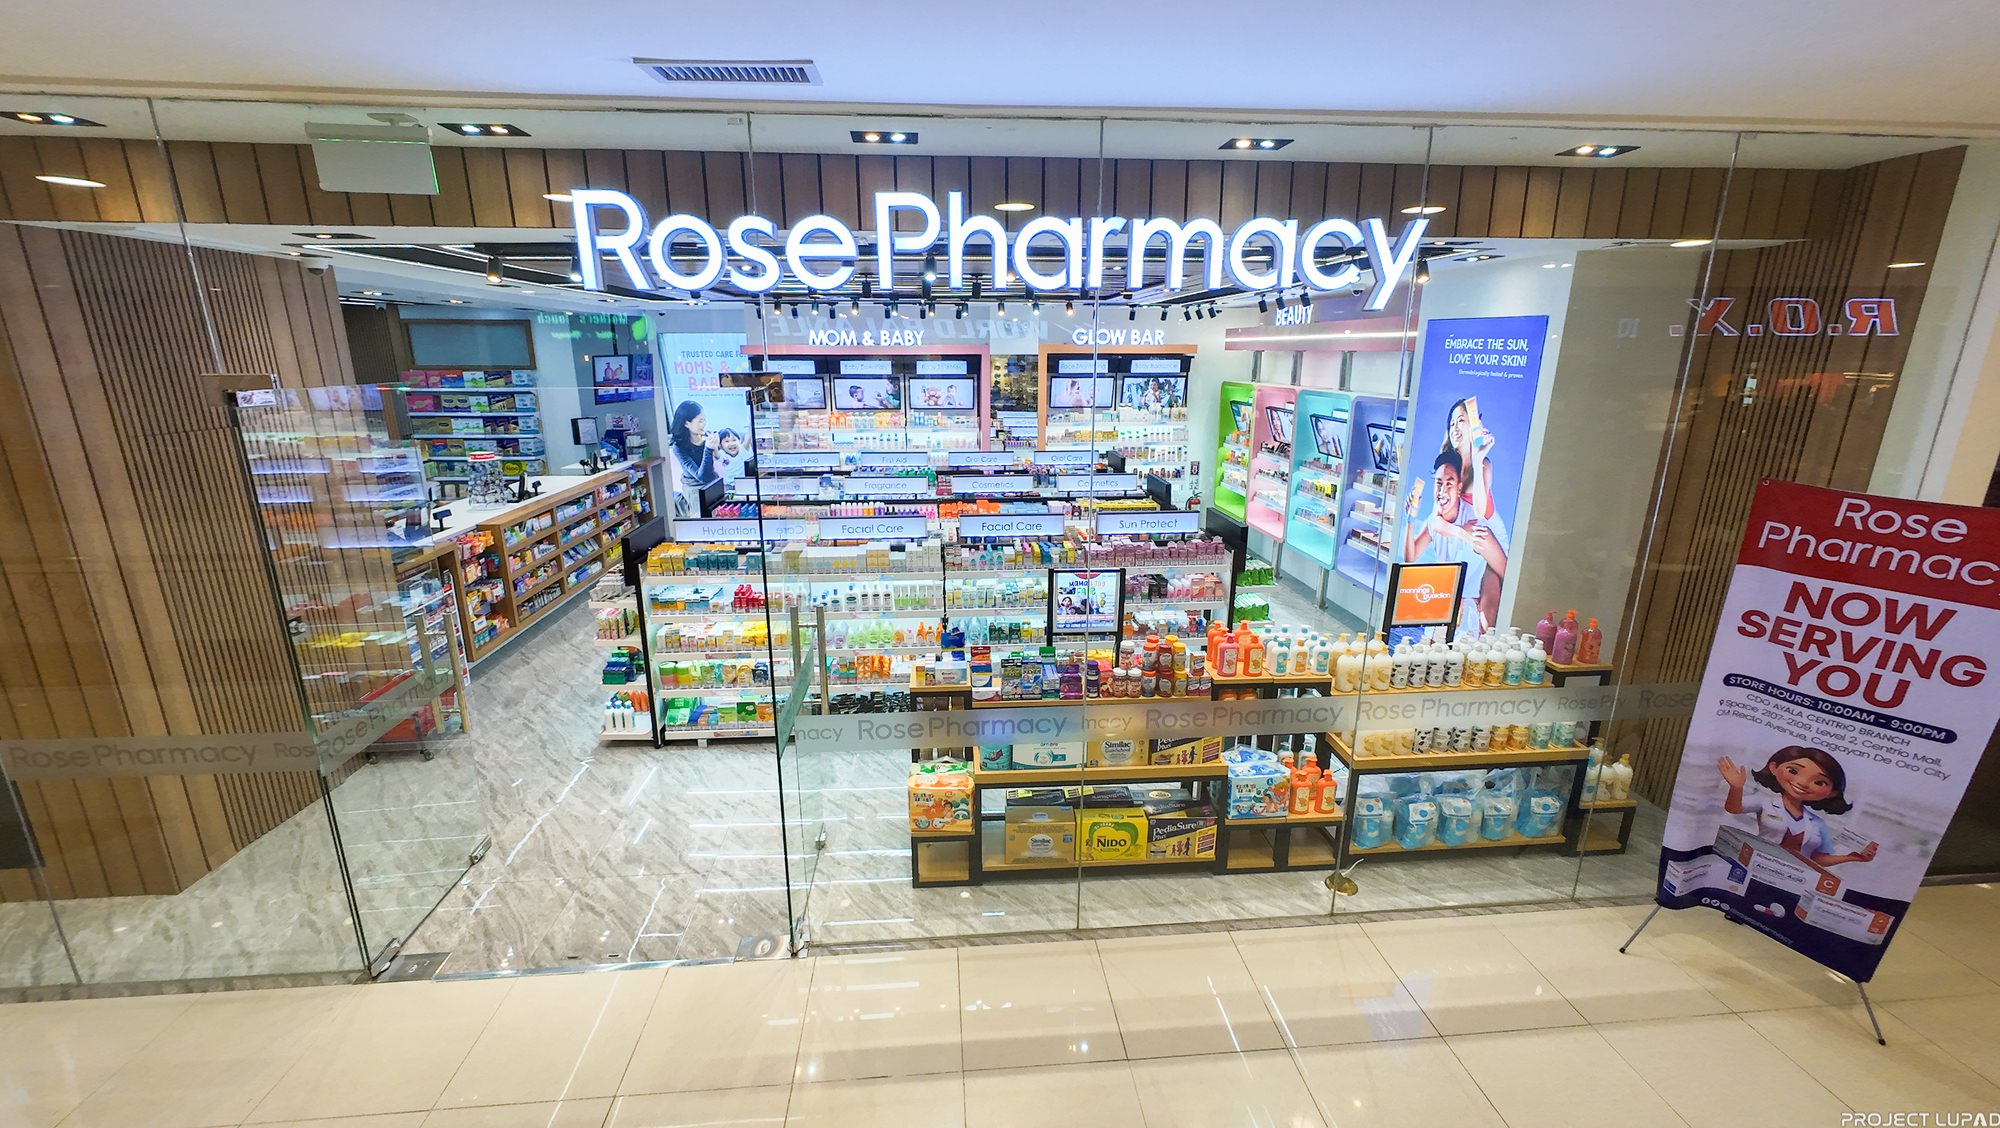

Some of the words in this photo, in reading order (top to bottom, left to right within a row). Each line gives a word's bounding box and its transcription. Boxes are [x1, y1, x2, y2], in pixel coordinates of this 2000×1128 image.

[570, 188, 860, 293] Rose
[873, 189, 1430, 313] Pharmacy
[1275, 304, 1314, 326] BEAUTY
[809, 329, 858, 346] MOM
[862, 330, 875, 346] &
[880, 329, 925, 346] BABY
[1072, 328, 1126, 345] GLOW
[1131, 328, 1165, 345] BAR
[1445, 338, 1484, 350] EMBRACE
[1487, 338, 1505, 350] THE
[1506, 338, 1529, 352] SUN,
[681, 350, 714, 358] TRUSTED
[715, 350, 734, 358] CARE
[1449, 353, 1472, 364] LOVE
[1474, 354, 1500, 365] YOUR
[1501, 355, 1528, 367] SKIN!
[674, 361, 714, 374] MOMS
[720, 361, 730, 373] &
[864, 482, 907, 492] Fragrance
[971, 481, 1015, 489] Cosmetics
[1077, 479, 1119, 487] Cometics
[981, 522, 1014, 531] Facial
[1016, 522, 1043, 531] Care
[1119, 519, 1138, 529] Sun
[1140, 519, 1178, 529] Protect
[1834, 497, 1968, 543] Rose
[702, 525, 757, 538] Hydration
[842, 524, 874, 534] Facial
[876, 524, 904, 533] Care
[1757, 520, 2000, 588] Pharmac
[1783, 581, 1958, 641] NOW
[1737, 609, 1988, 688] SERVING
[1783, 651, 1912, 709] YOU
[1357, 700, 1417, 722] Rose
[1421, 697, 1547, 720] Pharmacy
[1728, 676, 1766, 691] STORE
[1767, 685, 1814, 707] HOURS:
[1816, 700, 1876, 724] 10:00AM
[1889, 719, 1947, 741] 9:00PM
[1145, 708, 1209, 730] Rose
[1212, 706, 1345, 727] Pharmacy
[1746, 693, 1771, 706] CDO
[1772, 702, 1804, 719] AYALA
[1806, 713, 1857, 733] CENTRIO
[1858, 727, 1911, 747] BRANCH
[858, 719, 924, 741] Rose
[928, 716, 1068, 738] Pharmacy
[1725, 700, 1759, 715] Space
[1815, 725, 1846, 742] Level
[1861, 738, 1910, 759] Centrio
[274, 742, 315, 760] Ros
[1104, 740, 1132, 749] Similac
[1732, 709, 1763, 725] Recto
[1810, 735, 1871, 760] Cagayan
[1873, 752, 1892, 765] De
[1895, 760, 1921, 773] Oro
[1923, 766, 1952, 782] City
[8, 745, 91, 770] Rose
[92, 743, 258, 768] Pharmacy
[1153, 821, 1197, 837] PediaSure
[1096, 838, 1127, 848] NIDO
[1152, 834, 1168, 842] Plus
